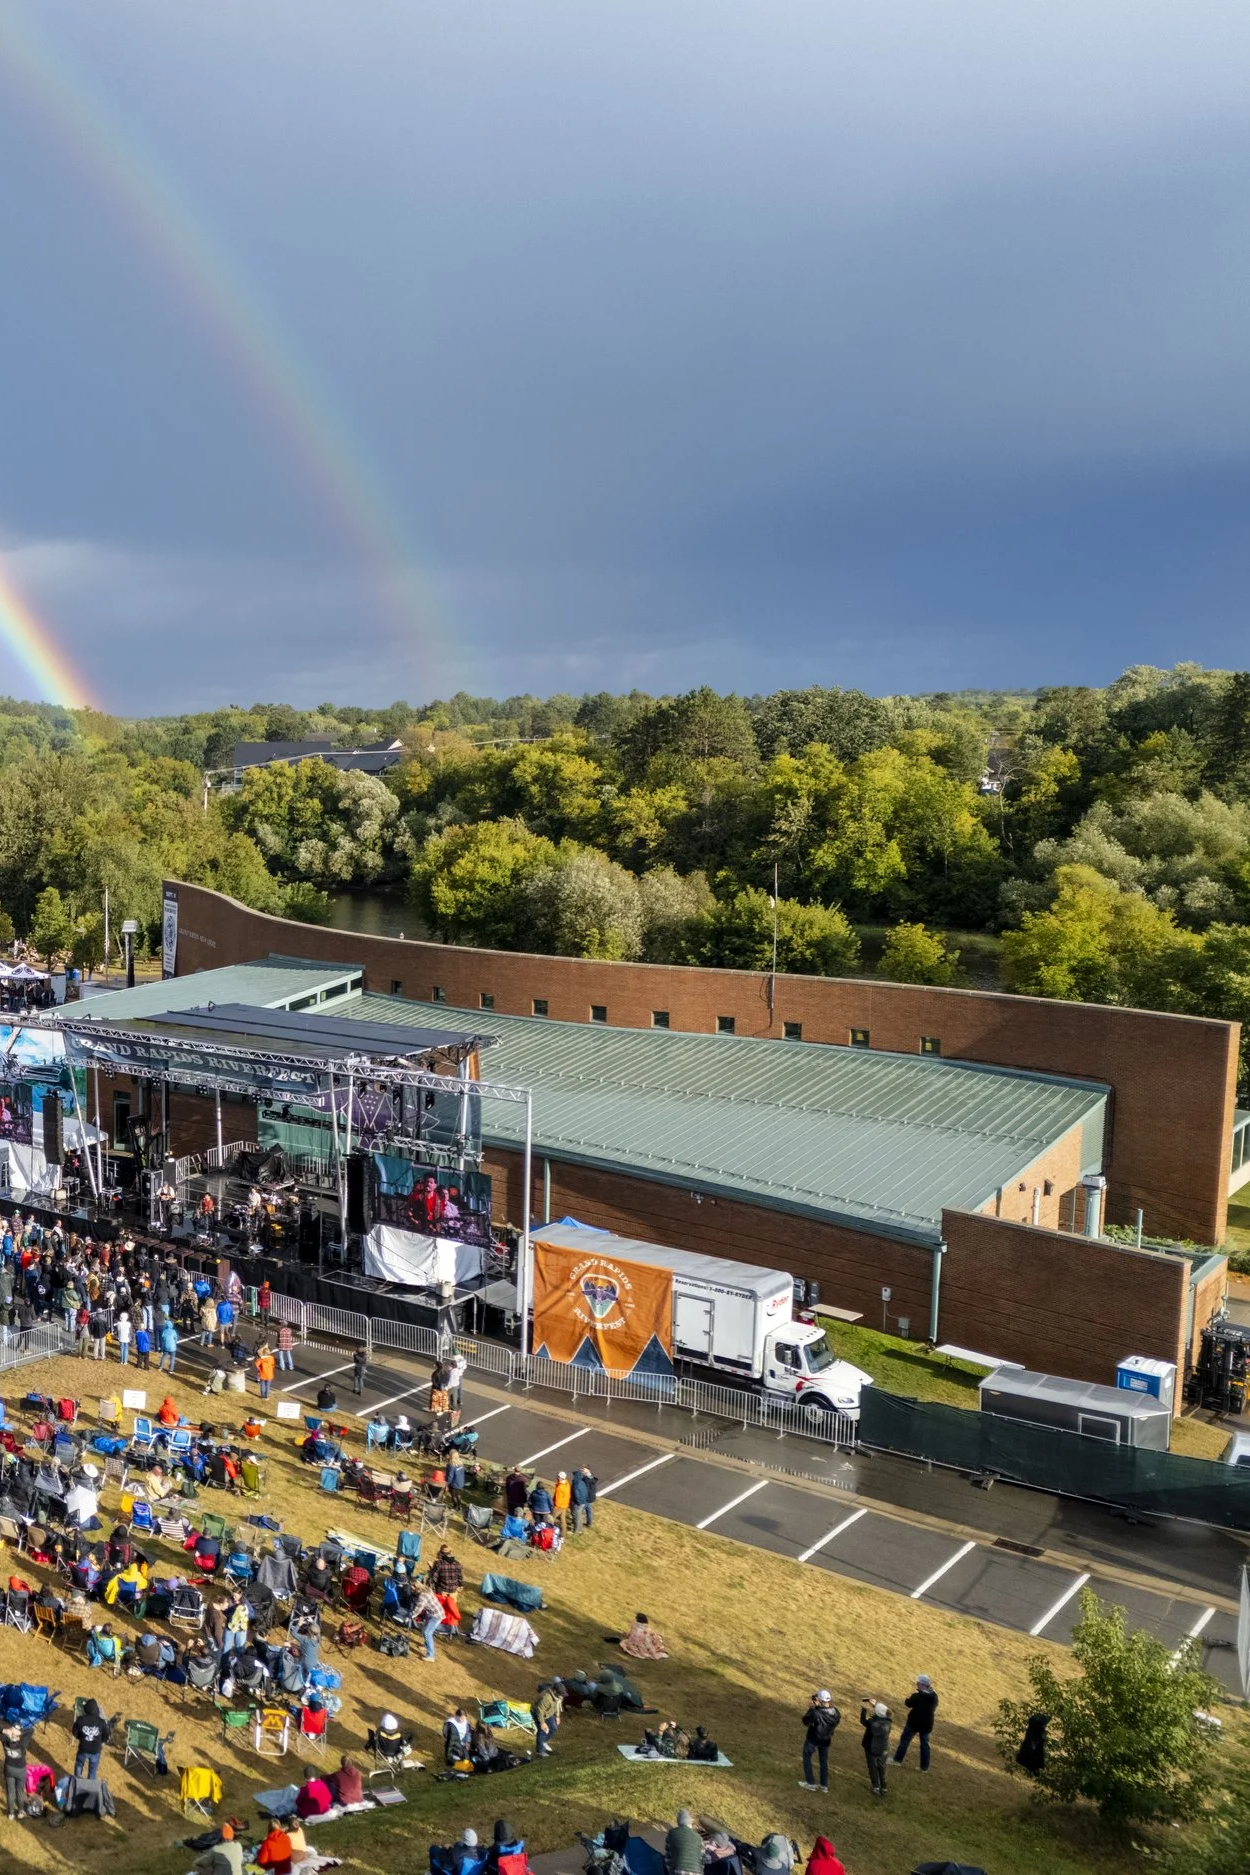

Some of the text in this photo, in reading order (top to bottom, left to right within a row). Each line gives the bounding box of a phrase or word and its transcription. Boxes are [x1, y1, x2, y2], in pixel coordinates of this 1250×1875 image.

[132, 1046, 204, 1065] RAPIDS
[206, 1056, 316, 1084] RIVERFEST
[569, 1257, 633, 1291] GRAND RAPIDS
[675, 1279, 709, 1291] Reservations:
[772, 1296, 790, 1310] Ryder
[573, 1307, 627, 1331] RIVERFEST
